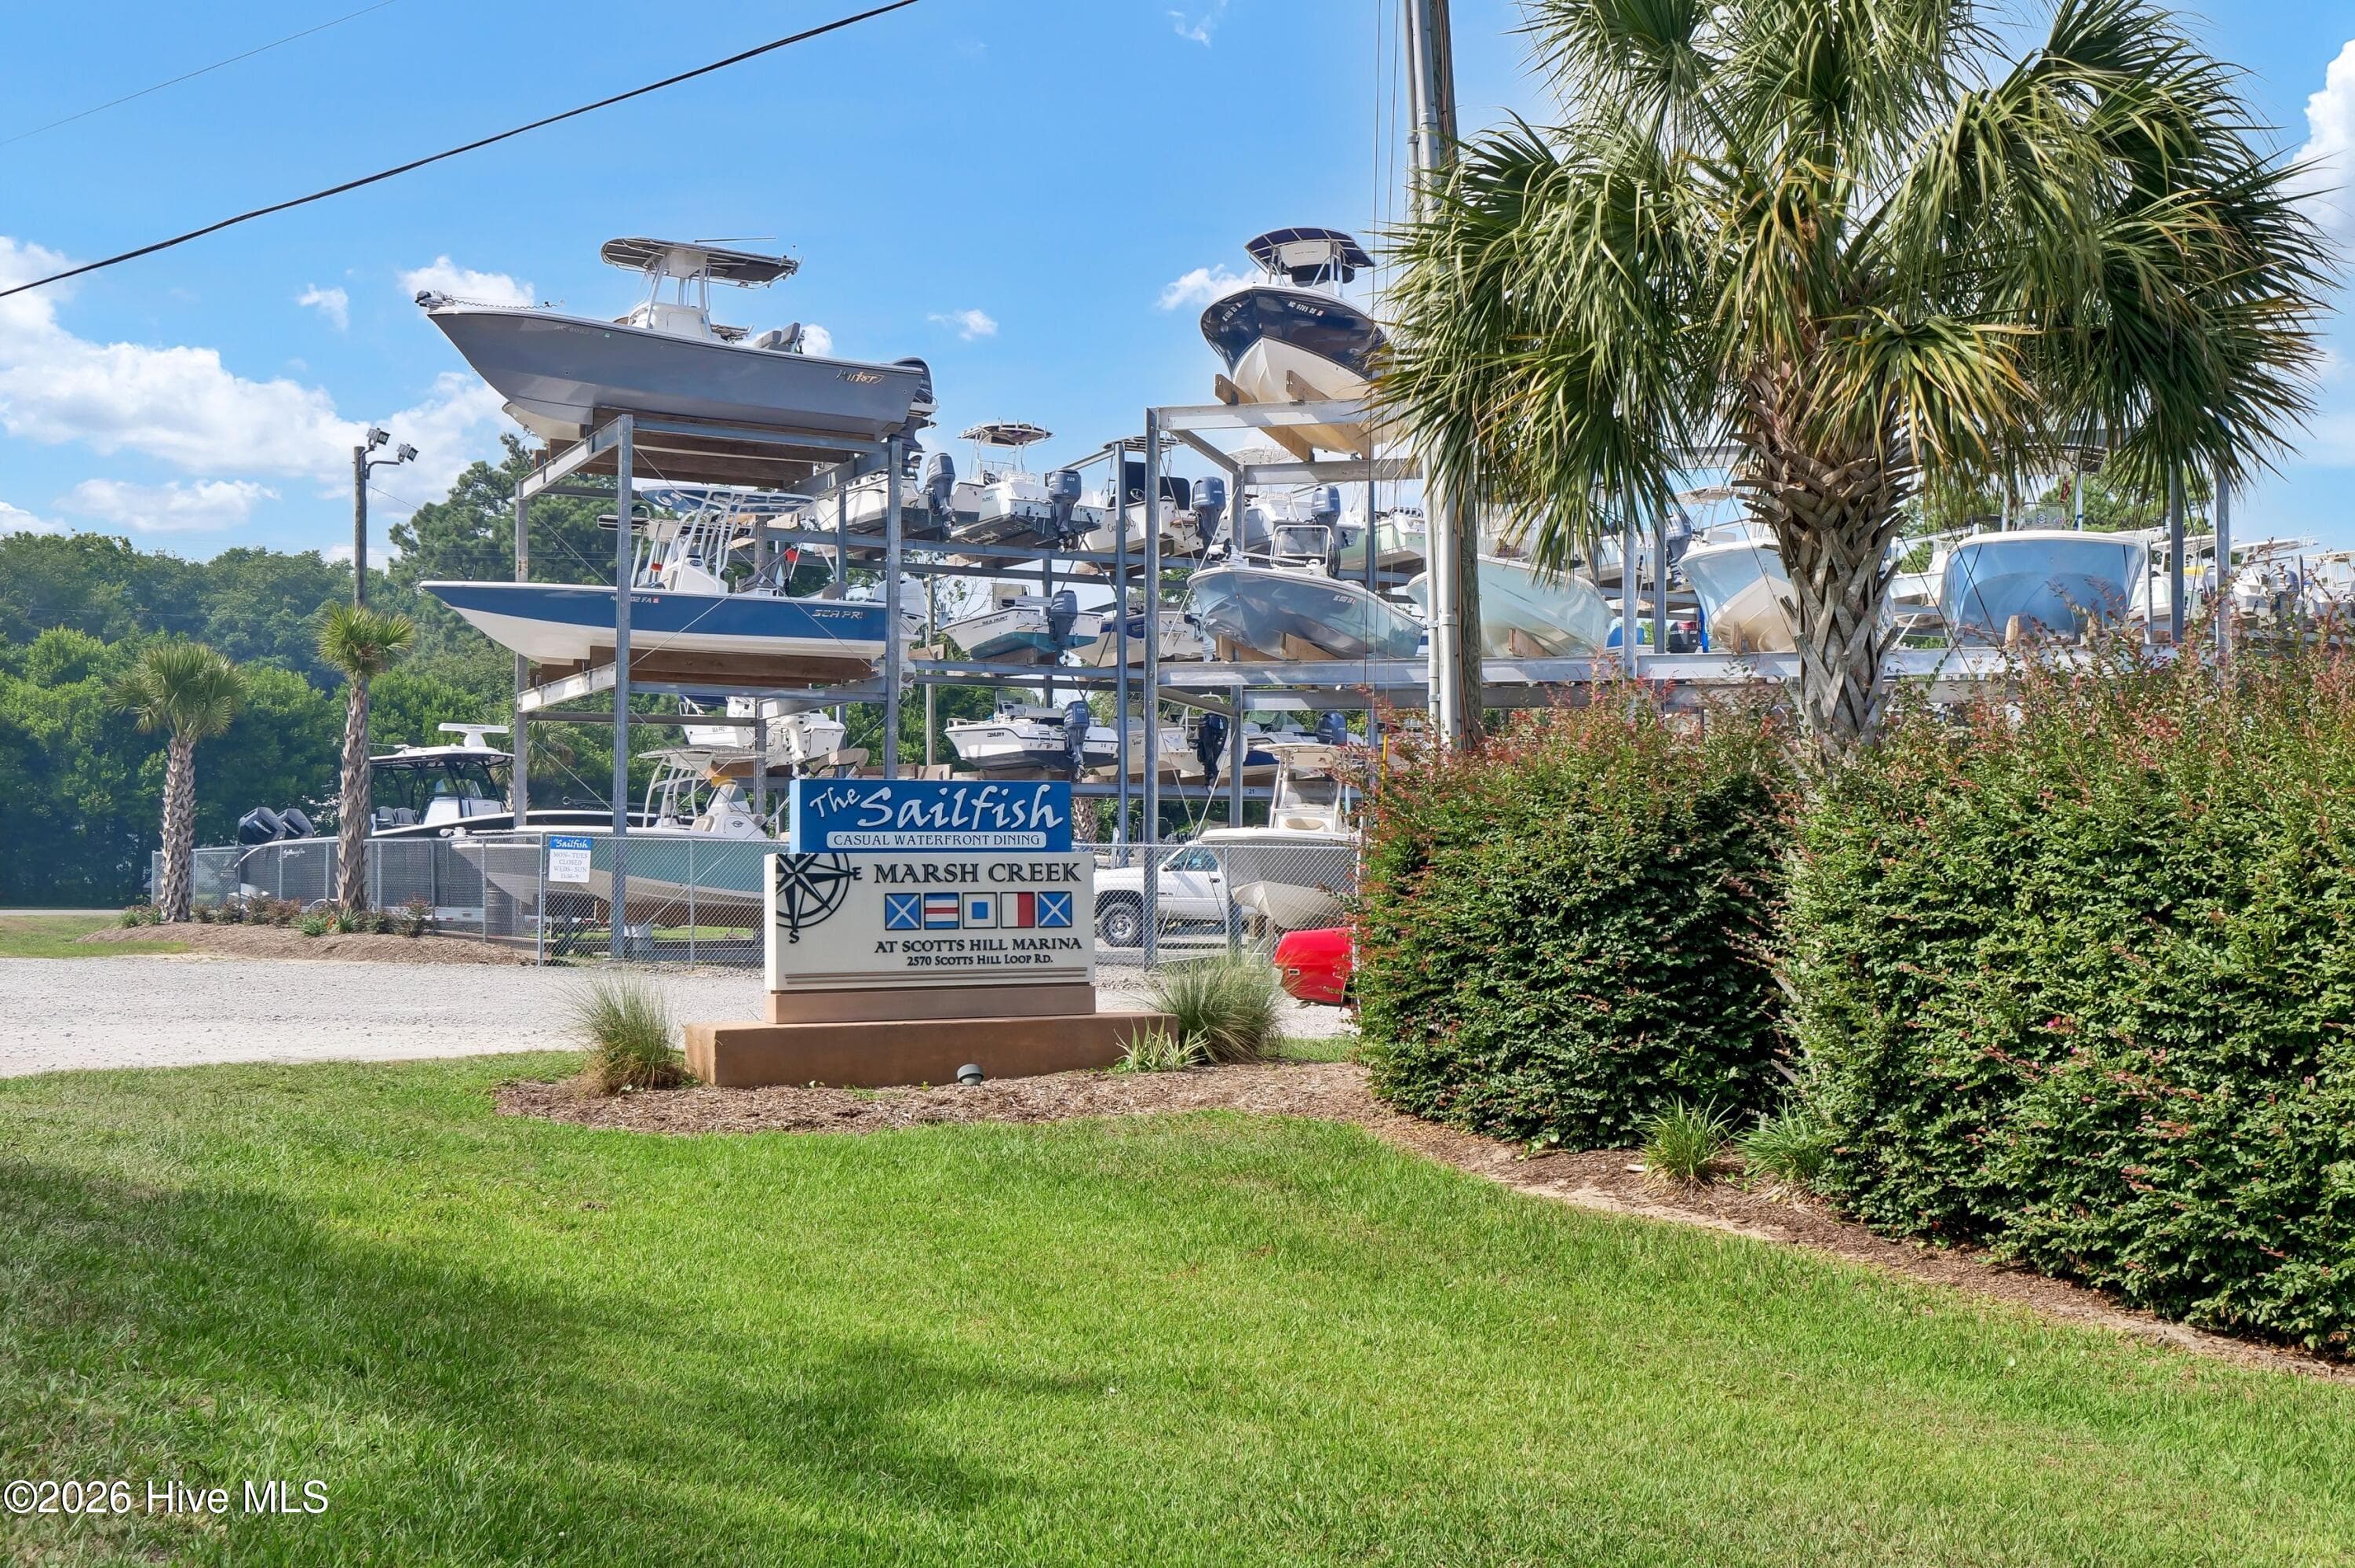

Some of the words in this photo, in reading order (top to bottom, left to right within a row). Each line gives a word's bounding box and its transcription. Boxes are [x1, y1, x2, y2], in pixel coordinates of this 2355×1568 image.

[809, 786, 860, 818] The
[857, 785, 1064, 830] Sailfish
[556, 839, 588, 848] Sailfish
[834, 834, 890, 845] CASUAL
[894, 834, 990, 845] WATERFRONT
[994, 834, 1040, 845] DINING
[874, 863, 980, 884] MARSH
[988, 862, 1082, 883] CREEK
[788, 929, 800, 944] S
[874, 941, 898, 954] AT
[902, 939, 966, 953] SCOTTS
[969, 939, 1008, 951] HILL
[1012, 937, 1083, 950] MARINA
[907, 956, 932, 967] 2570
